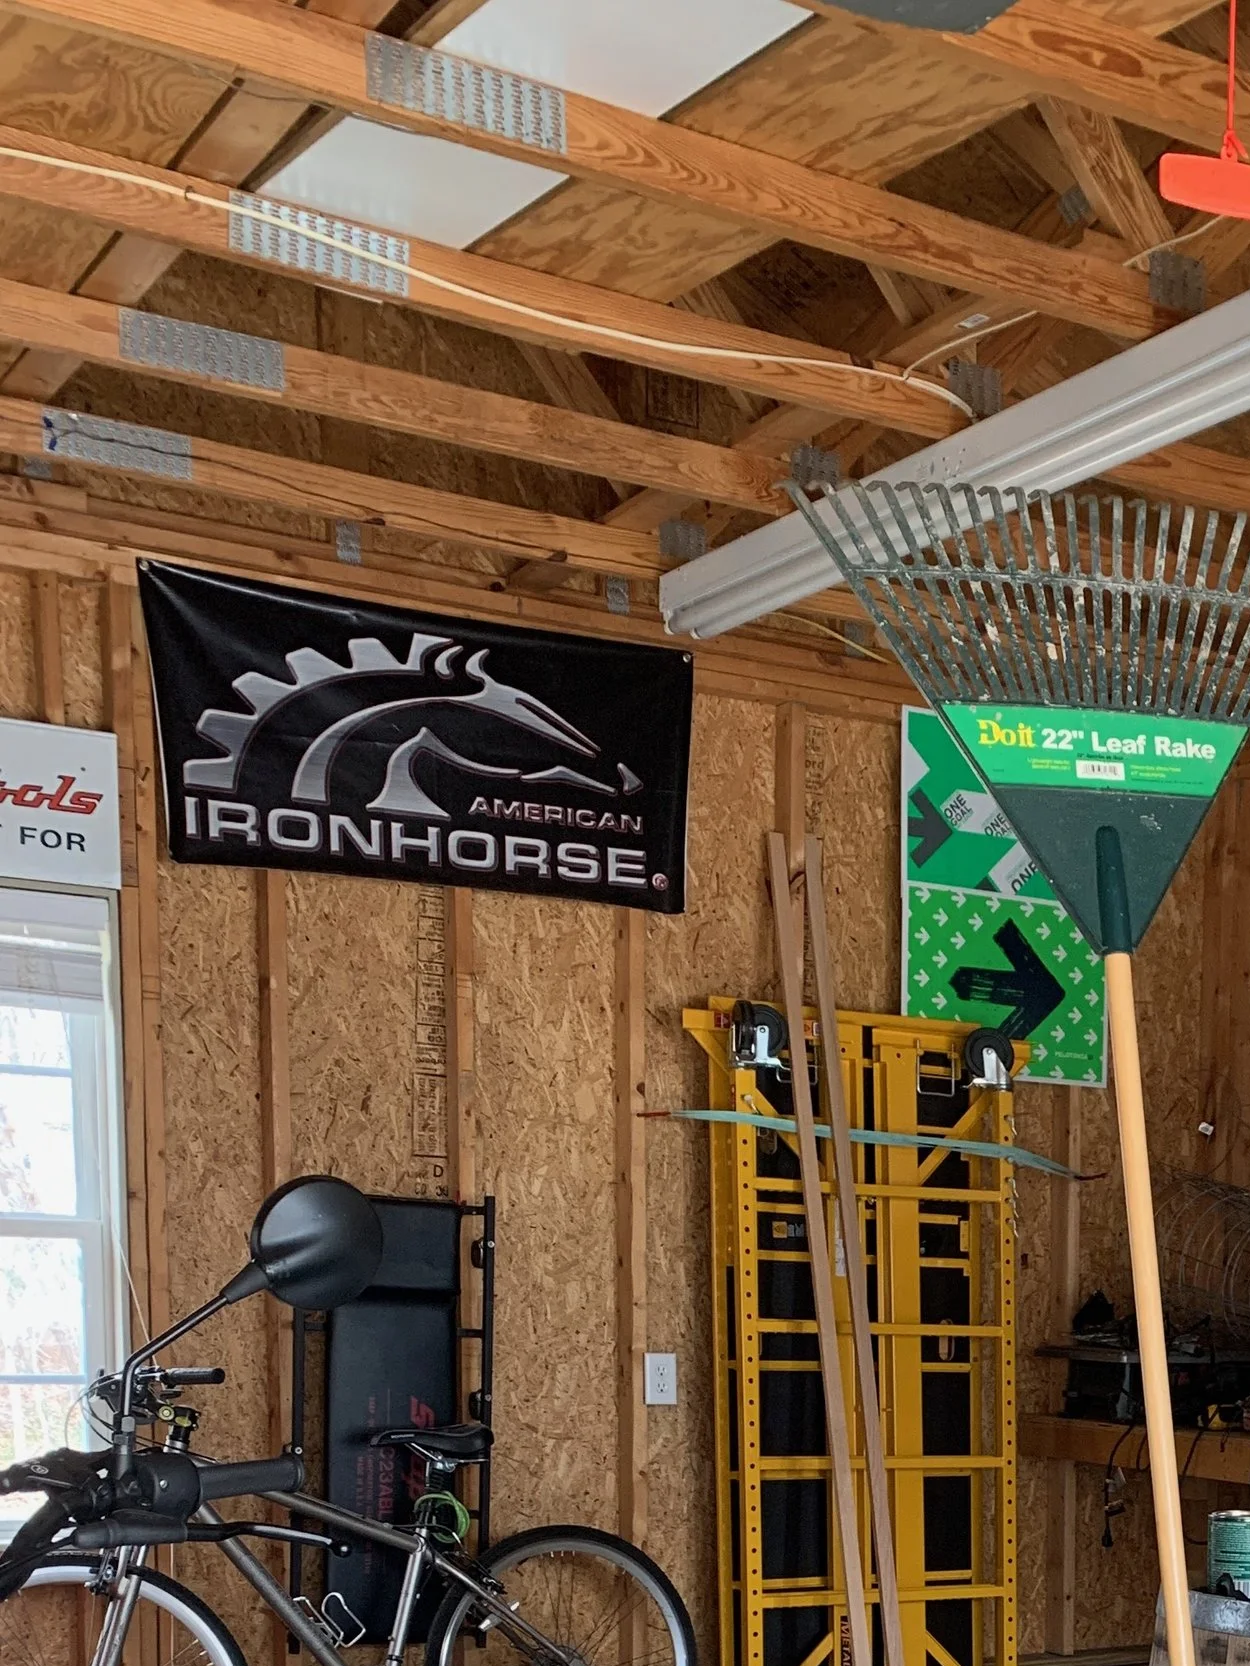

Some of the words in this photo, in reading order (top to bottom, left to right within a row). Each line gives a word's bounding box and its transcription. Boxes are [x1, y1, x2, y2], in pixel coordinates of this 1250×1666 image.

[1041, 728, 1085, 750] 22"
[1091, 731, 1147, 755] Leaf
[1154, 736, 1217, 760] Rake
[0, 775, 103, 814] ols
[943, 794, 967, 820] ONE
[468, 796, 644, 834] AMERICAN
[20, 826, 86, 852] FOR
[184, 796, 648, 887] IRONHORSE
